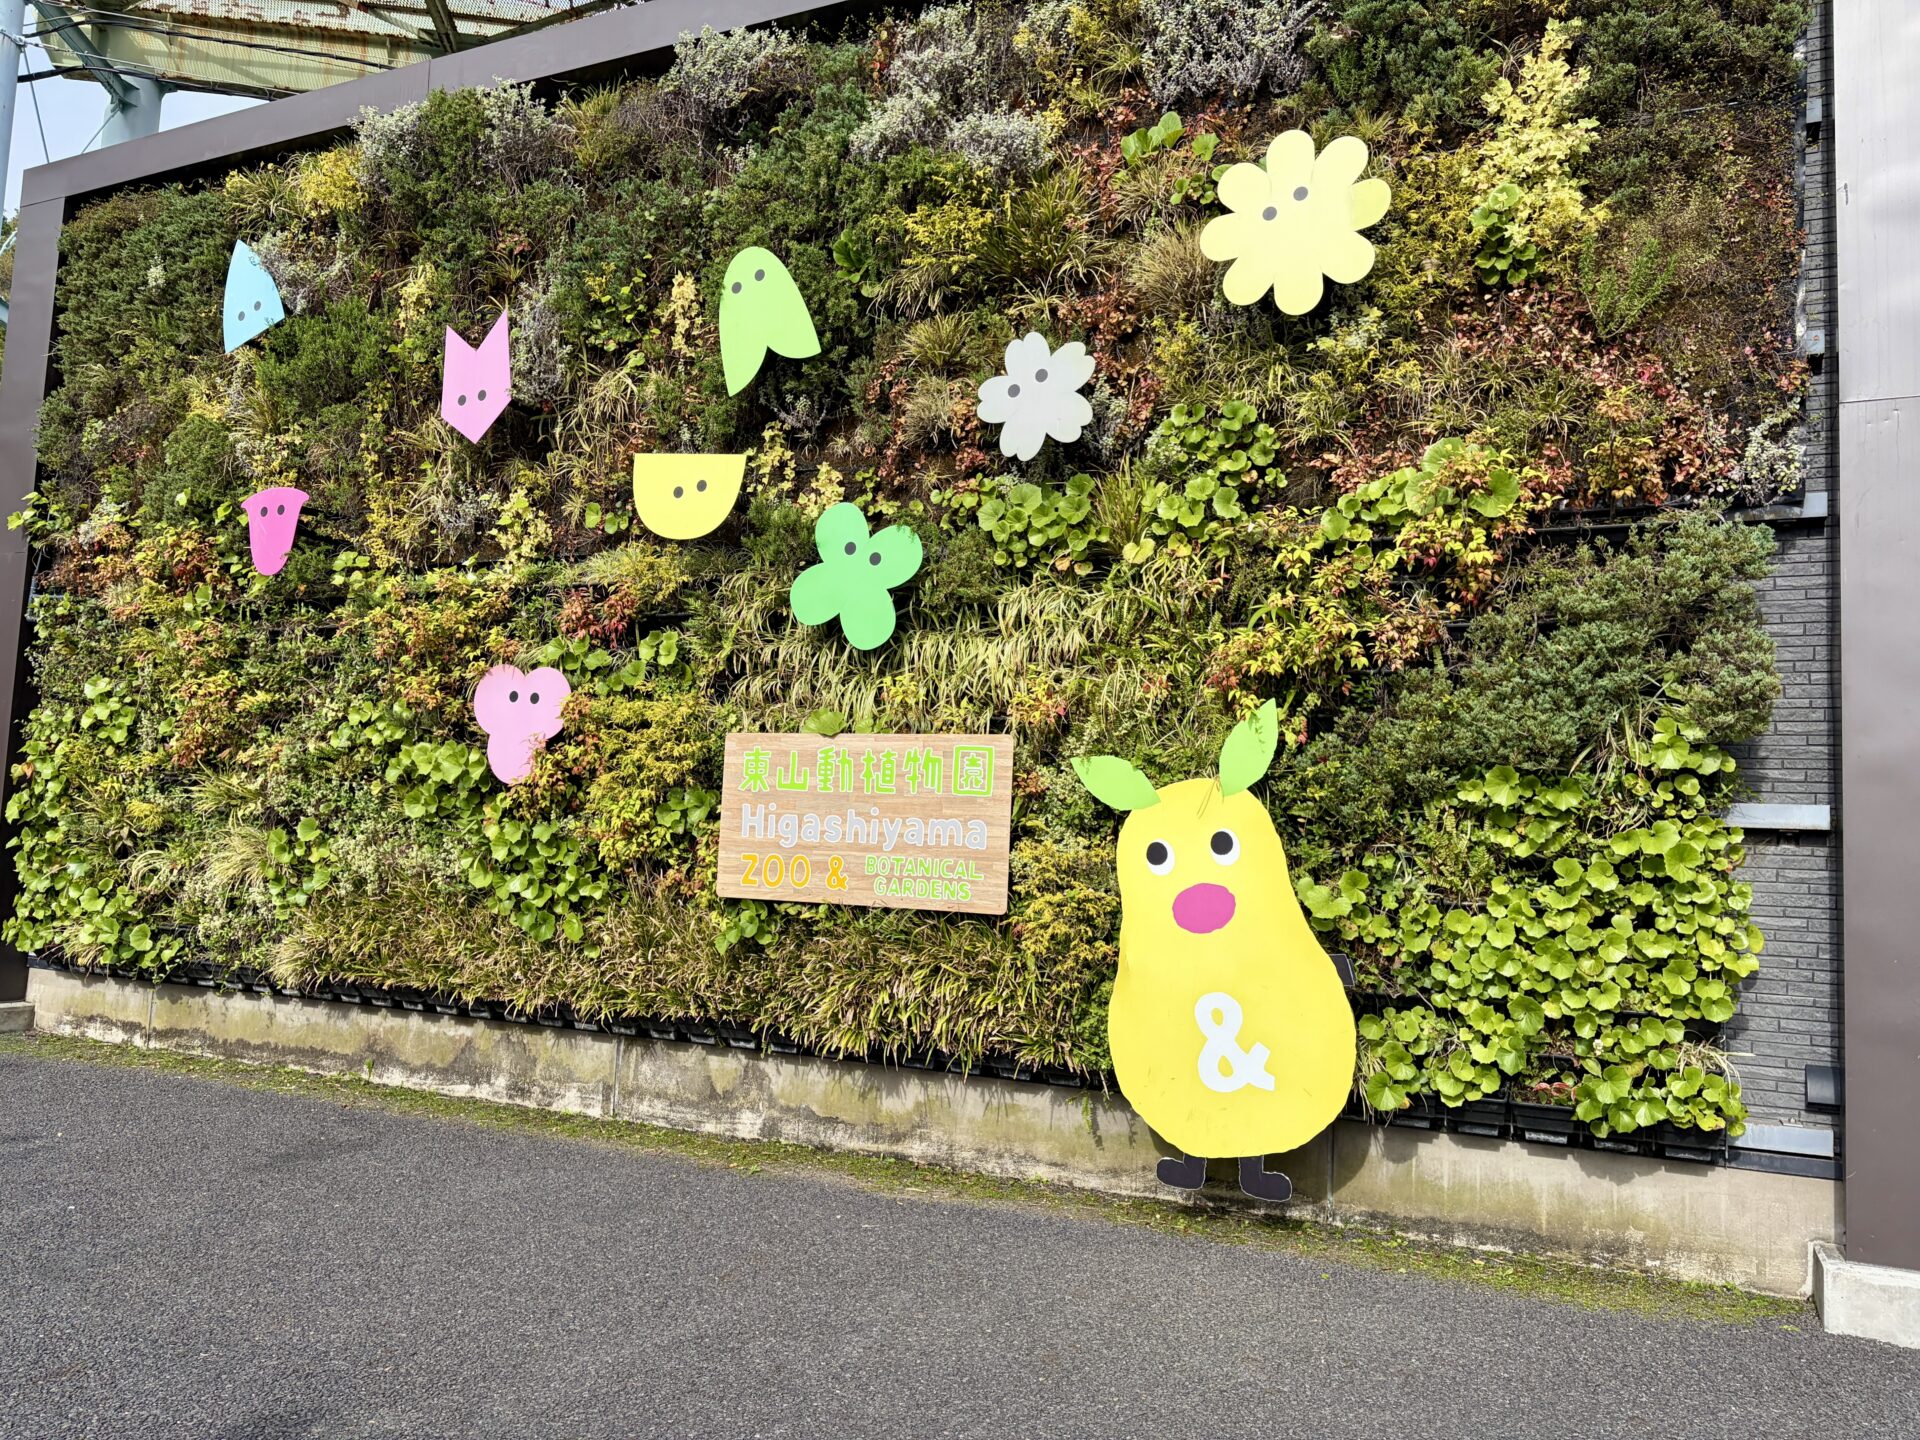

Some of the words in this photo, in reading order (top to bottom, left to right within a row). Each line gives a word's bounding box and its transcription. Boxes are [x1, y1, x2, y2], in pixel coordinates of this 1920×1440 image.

[738, 744, 995, 797] 東山動植物園
[741, 802, 988, 851] Higashiyama
[740, 853, 811, 889] ZOO
[825, 855, 848, 891] &
[864, 855, 984, 880] BOTANICAL
[873, 878, 972, 901] GARDENS
[1195, 991, 1276, 1093] &
